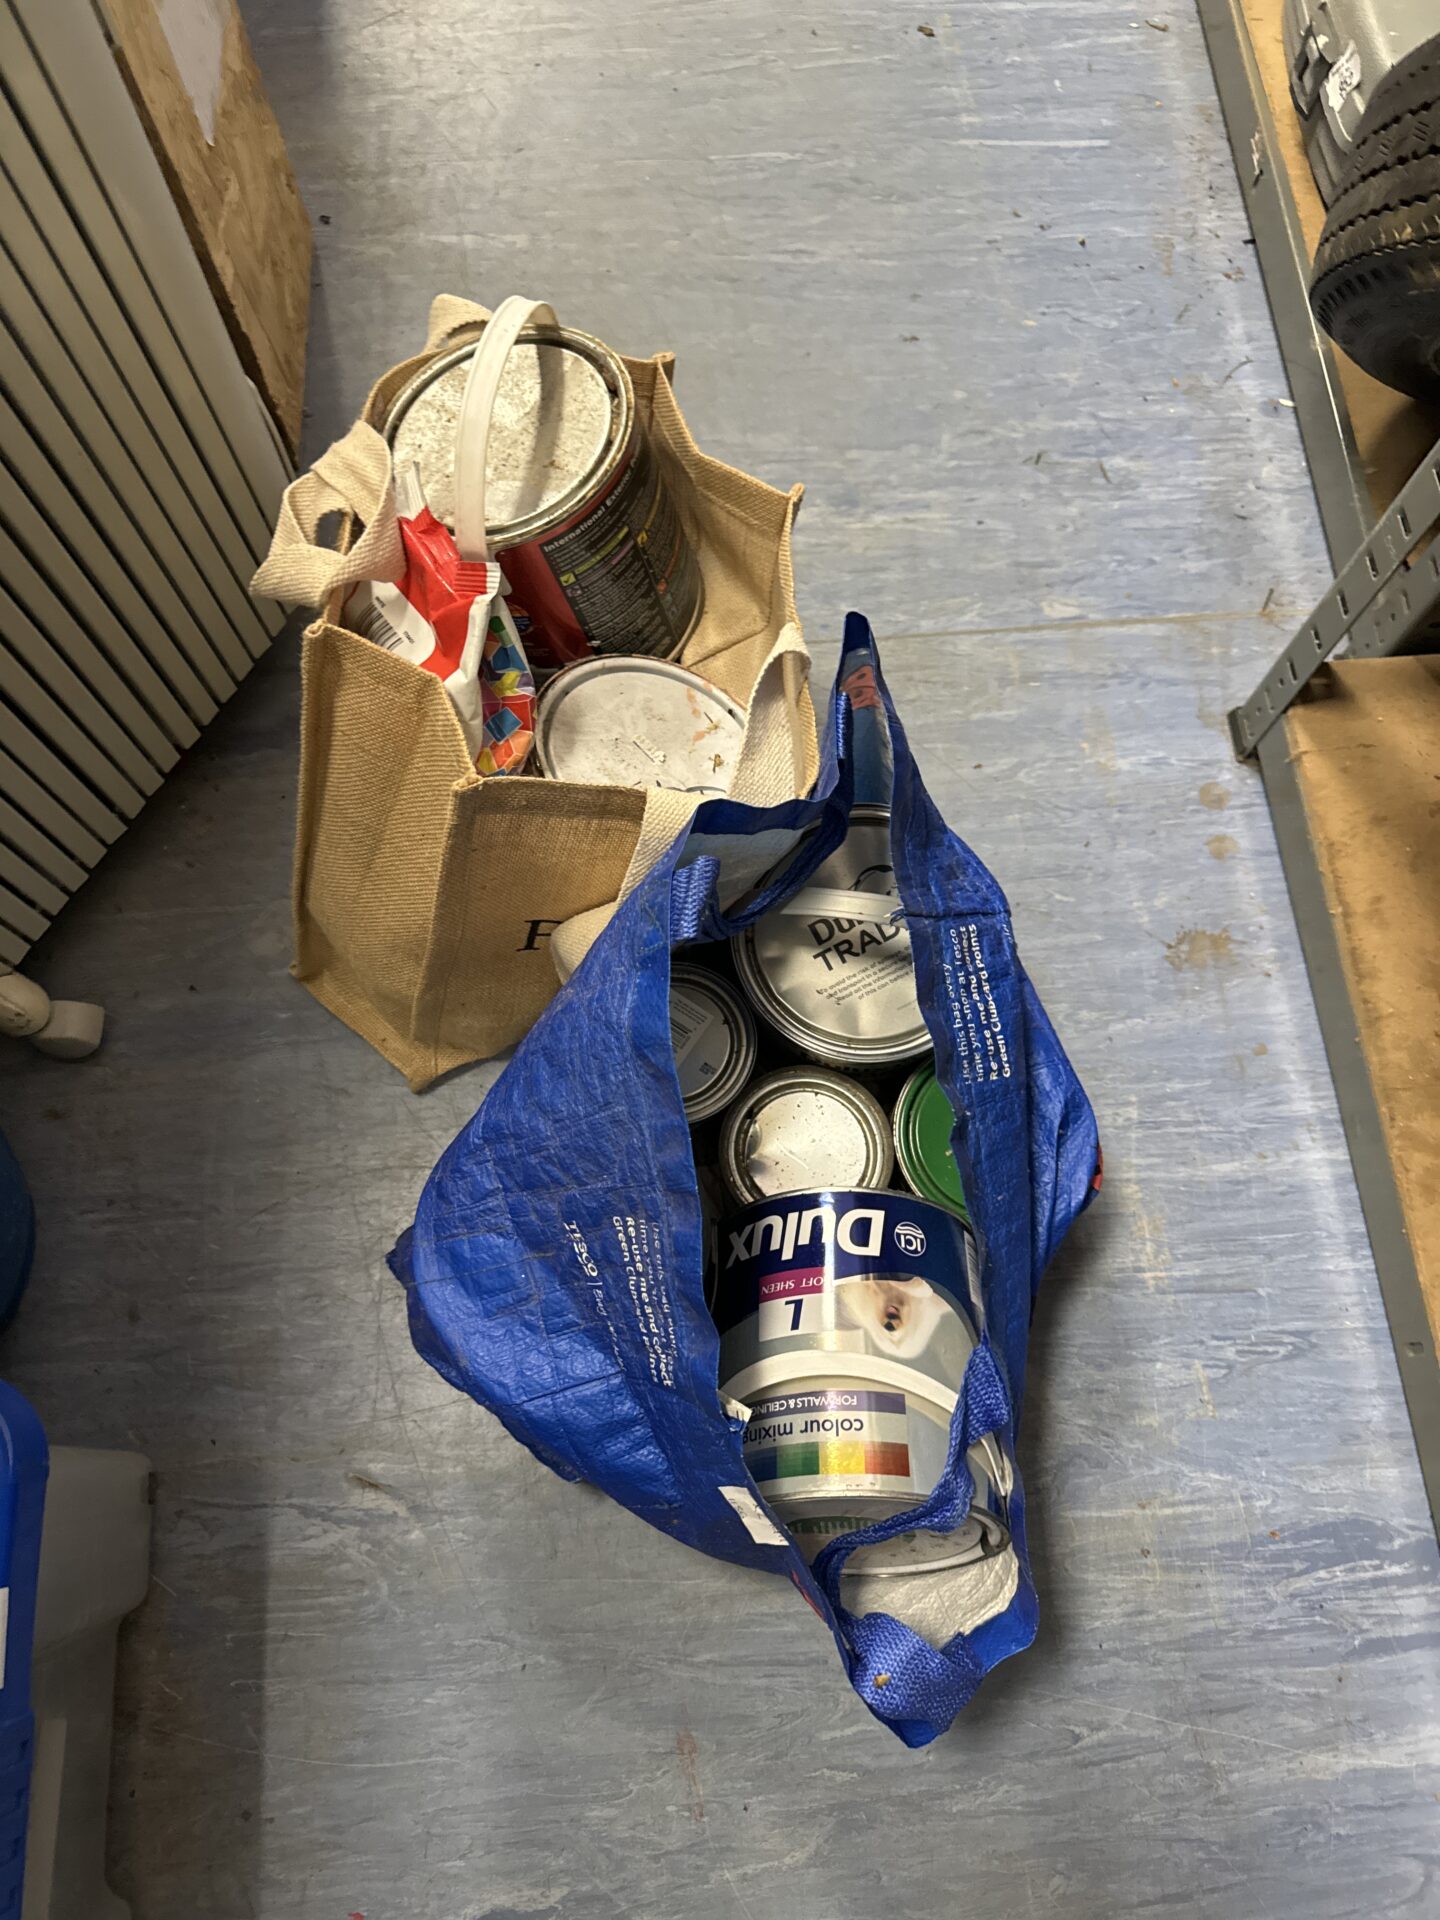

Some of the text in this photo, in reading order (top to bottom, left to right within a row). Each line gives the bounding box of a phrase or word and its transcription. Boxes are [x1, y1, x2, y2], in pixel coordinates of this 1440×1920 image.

[543, 505, 606, 553] International
[812, 922, 902, 971] TRAD
[942, 963, 955, 998] every
[952, 1002, 963, 1028] bag
[968, 923, 1011, 1079] Green Clubcard points
[977, 1002, 988, 1024] me
[956, 1030, 969, 1056] this
[983, 1029, 998, 1081] Re-use
[565, 1220, 598, 1277] TESCO
[613, 1216, 630, 1262] Green
[625, 1216, 644, 1273] Re-use
[725, 1207, 886, 1270] Dulux
[900, 1233, 922, 1253] ICI
[640, 1277, 649, 1303] me
[760, 1275, 829, 1295] OFT SHEEN
[644, 1305, 659, 1333] and
[784, 1298, 804, 1331] L
[652, 1336, 674, 1388] collect
[787, 1398, 796, 1409] &
[797, 1395, 835, 1408] WALLS
[742, 1418, 864, 1446] colour mixing
